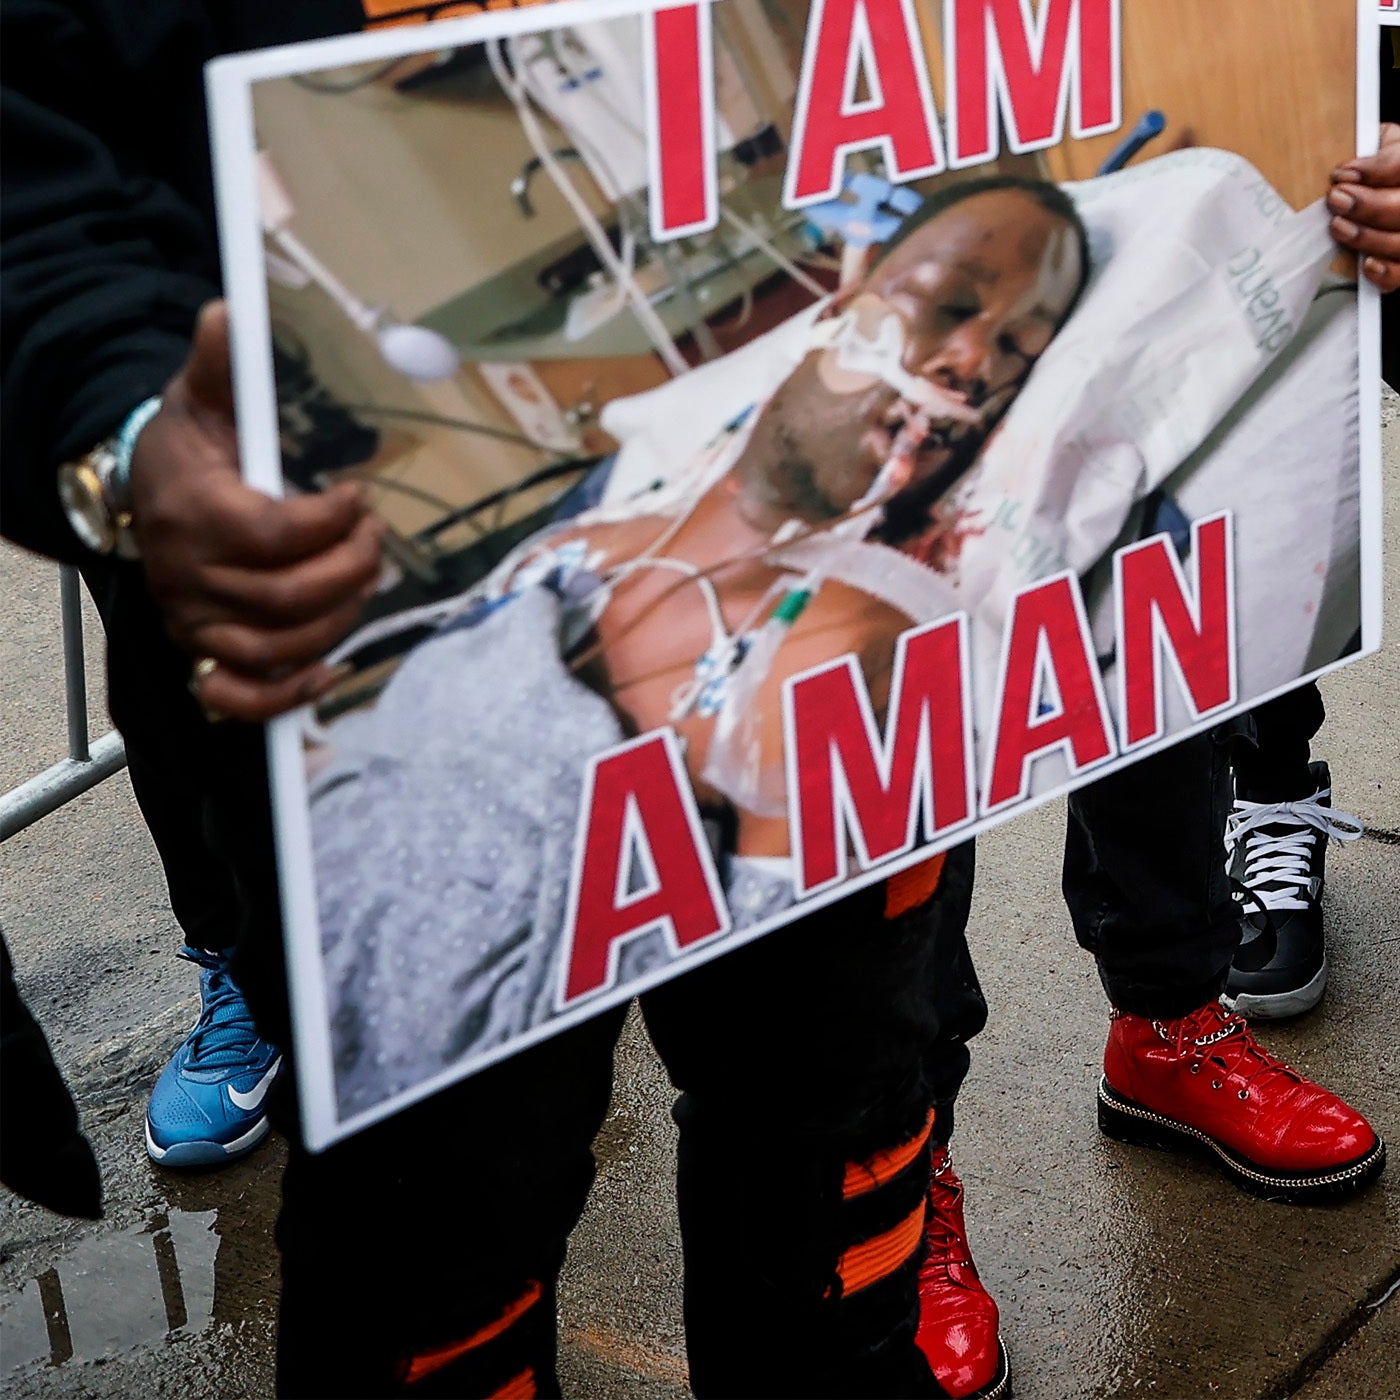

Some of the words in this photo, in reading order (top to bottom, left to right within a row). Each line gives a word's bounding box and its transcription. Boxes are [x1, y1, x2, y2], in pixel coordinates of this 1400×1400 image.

[640, 0, 717, 242] I
[555, 727, 733, 1016] A
[782, 508, 1237, 905] MAN
